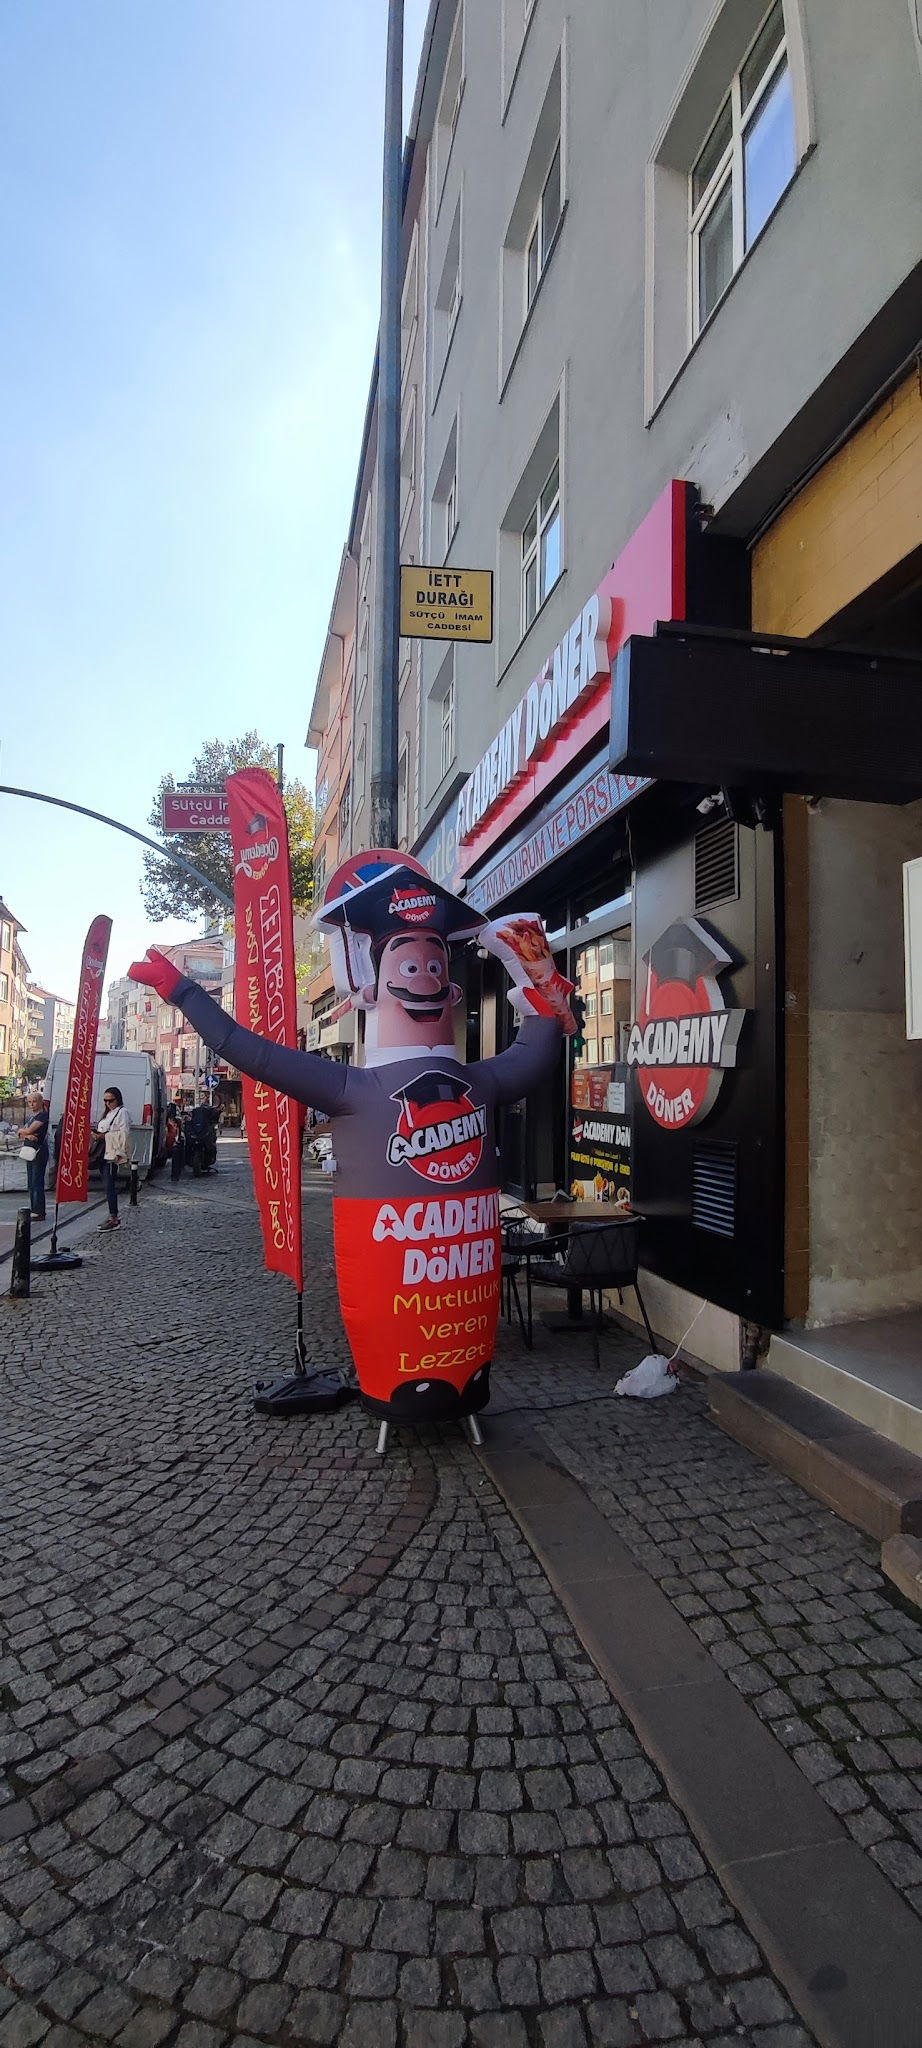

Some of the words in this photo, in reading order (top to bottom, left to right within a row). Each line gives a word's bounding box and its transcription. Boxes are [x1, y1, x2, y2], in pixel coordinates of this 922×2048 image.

[428, 570, 462, 588] İETT
[416, 590, 474, 606] DURAĞI
[409, 610, 445, 620] SÜTÇÜ
[455, 612, 483, 621] İMAM
[427, 622, 472, 631] CADDESİ
[456, 698, 525, 842] ACADEMY
[525, 594, 599, 761] DÖNER
[547, 818, 565, 855] VE
[388, 894, 437, 914] ACADEMY
[627, 1013, 729, 1066] ACADEMY
[646, 1081, 696, 1124] DÖNER
[390, 1108, 486, 1163] ACADEMY
[582, 1120, 616, 1145] ACADEMY
[426, 1152, 477, 1179] DÖNER
[372, 1191, 501, 1242] ACADEMY
[402, 1237, 496, 1285] DÖNER
[393, 1279, 499, 1316] Mutluluk
[419, 1314, 488, 1341] veren
